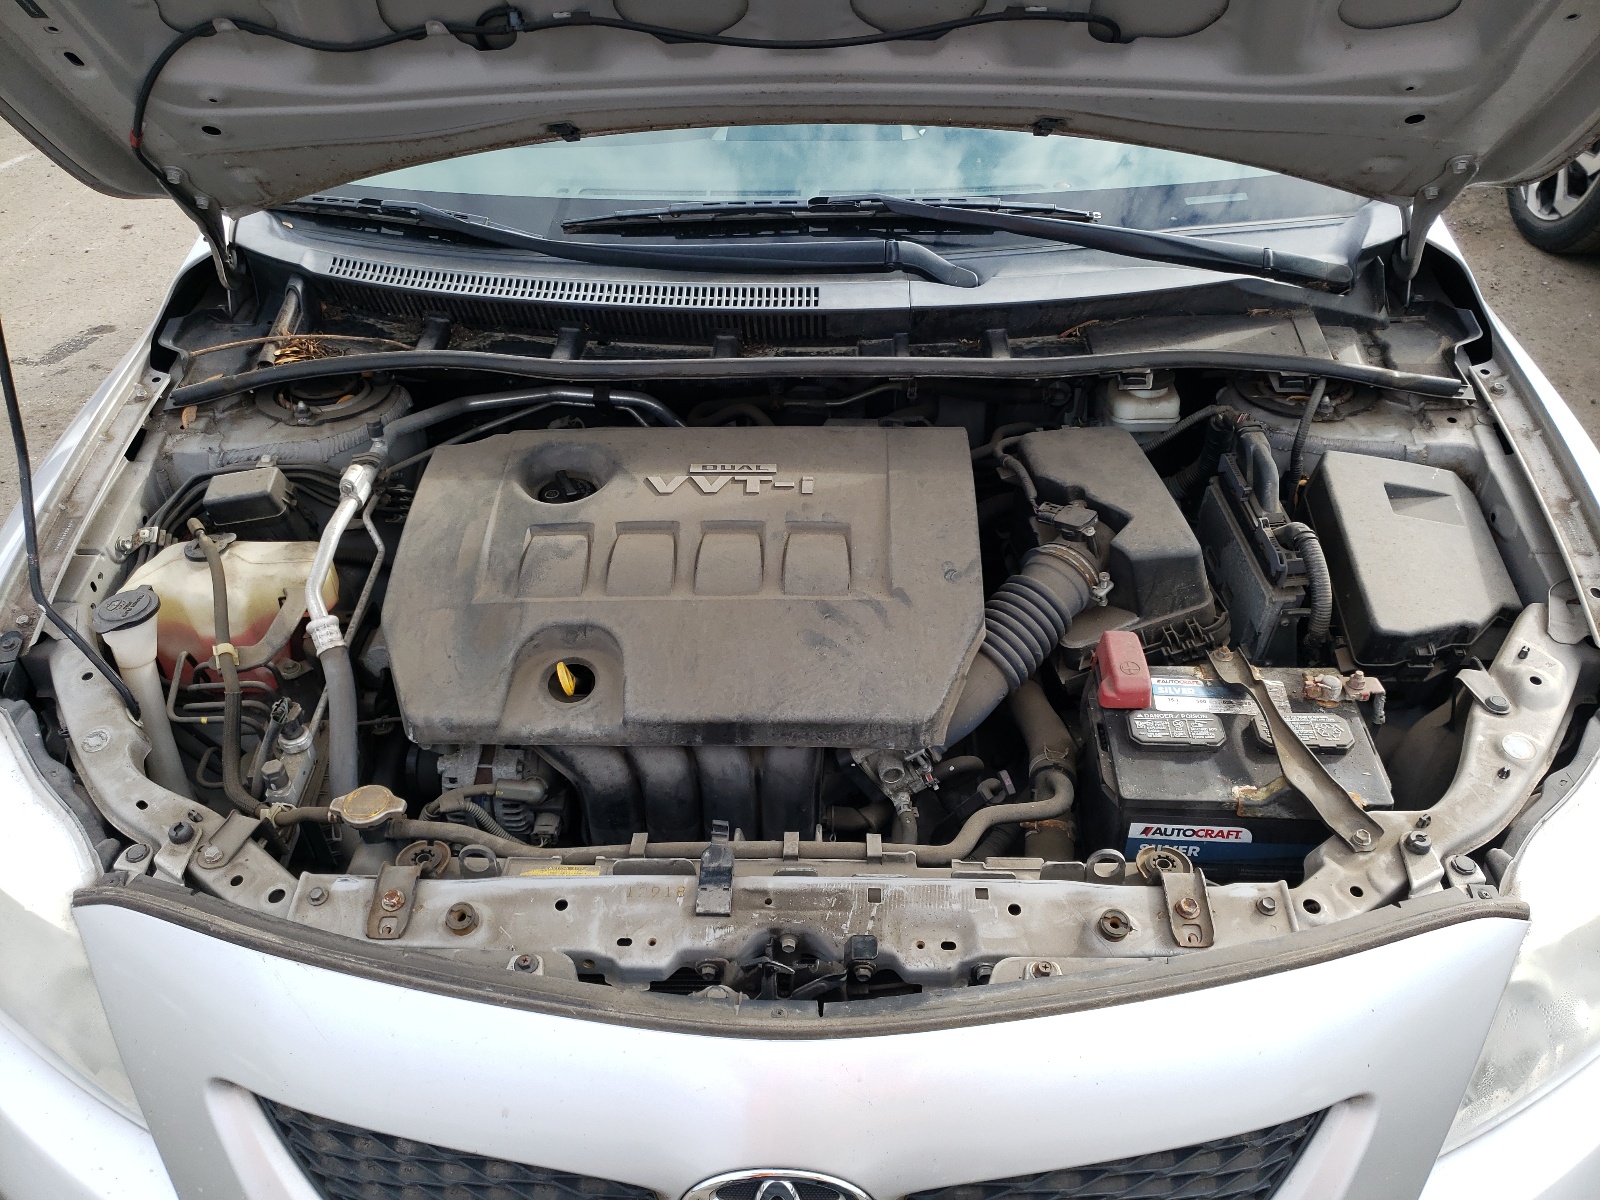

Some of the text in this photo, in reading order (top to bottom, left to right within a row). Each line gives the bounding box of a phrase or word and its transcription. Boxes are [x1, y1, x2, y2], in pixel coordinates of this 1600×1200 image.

[646, 475, 814, 494] VVT-i
[1157, 686, 1196, 695] SILVER
[1151, 826, 1243, 840] AUTOCRAFT
[1138, 843, 1201, 857] SER
